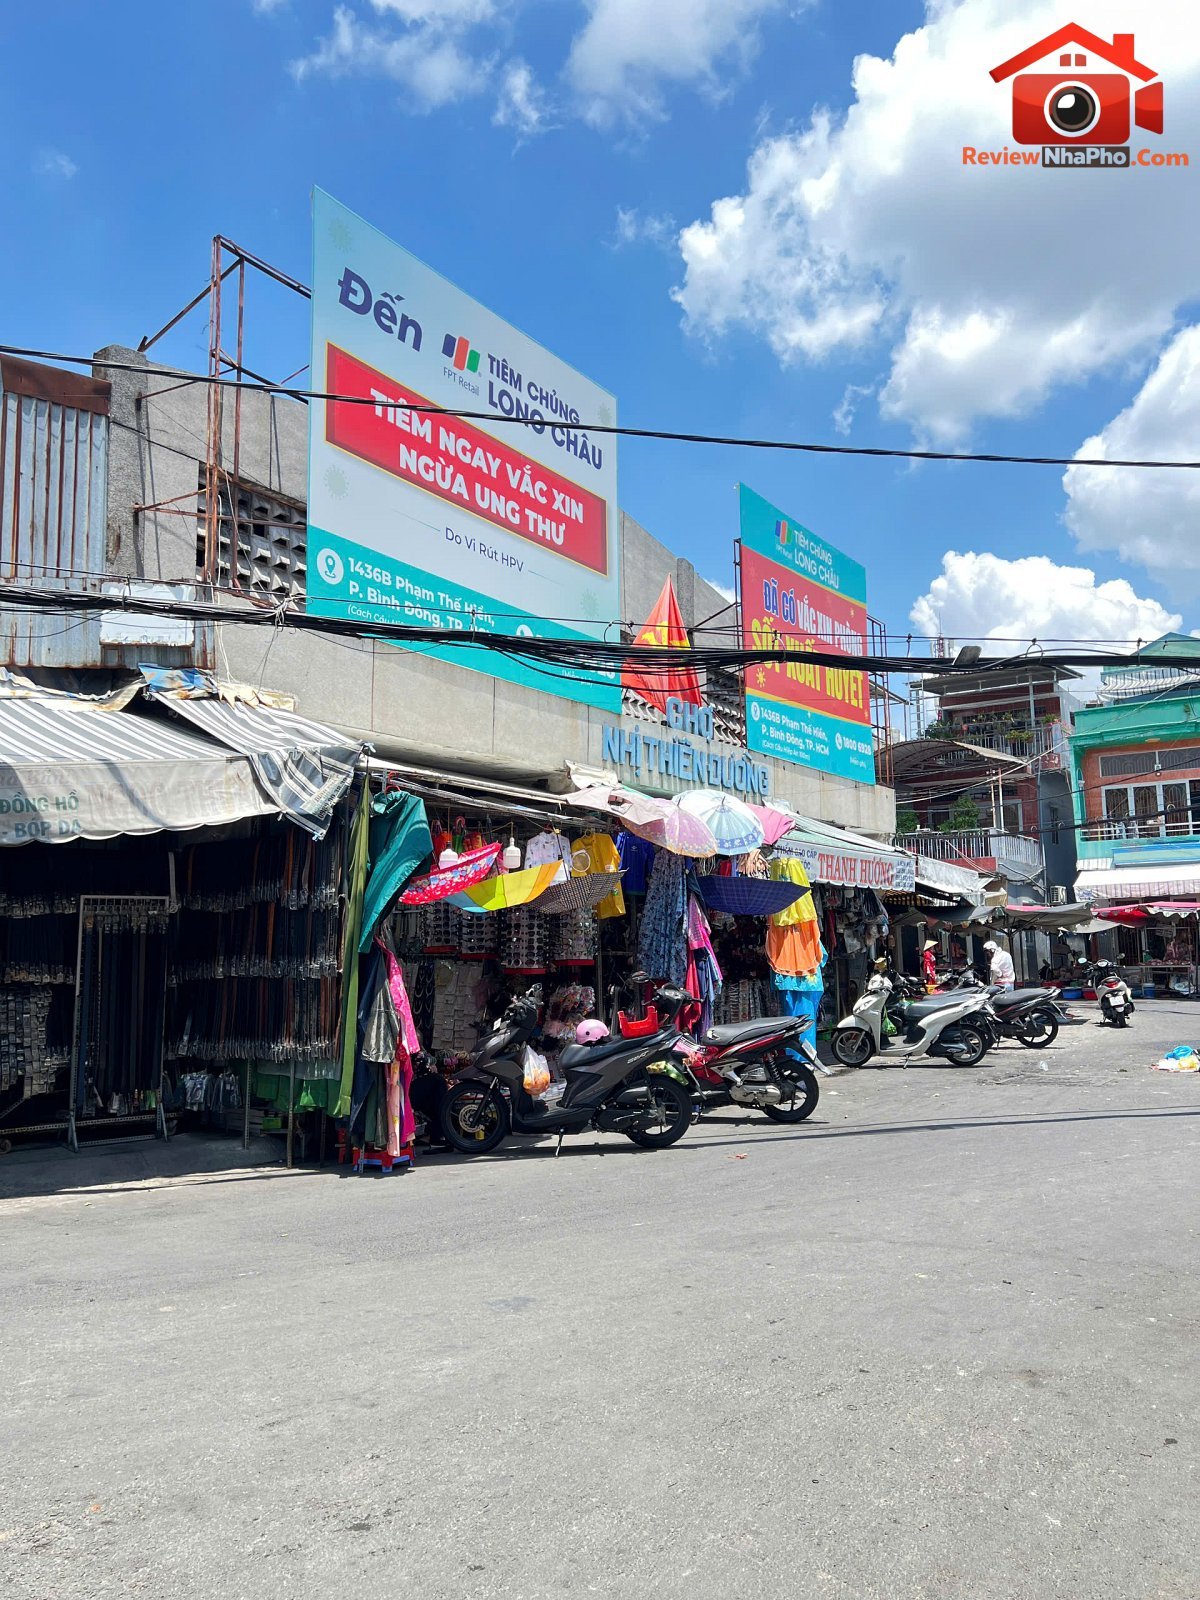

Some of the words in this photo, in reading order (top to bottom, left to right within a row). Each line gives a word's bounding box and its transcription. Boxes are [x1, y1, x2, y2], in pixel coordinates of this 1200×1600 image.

[337, 266, 423, 352] Đến
[443, 367, 457, 384] FPT
[458, 372, 480, 396] Retail
[487, 353, 522, 392] TIÊM
[527, 378, 580, 425] CHỦNG
[487, 381, 545, 435] LONG
[551, 423, 603, 470] CHÂU
[370, 388, 432, 444] TIÊM
[439, 427, 501, 479] NGAY
[506, 463, 547, 504] VẮC
[552, 488, 584, 523] XIN
[400, 444, 469, 501] NGỪA
[475, 483, 520, 524] UNG
[525, 508, 566, 546] THƯ
[445, 527, 462, 545] Do
[465, 538, 476, 553] Vi
[480, 543, 498, 563] Rút
[501, 555, 524, 572] HPV
[794, 530, 809, 550] TIÊM
[348, 557, 392, 586] 1436B
[395, 575, 434, 602] Phạm
[437, 591, 462, 612] Thế
[795, 548, 817, 575] LONG
[818, 565, 839, 589] CHÂU
[347, 604, 372, 620] (Cách
[349, 580, 363, 599] P.
[367, 586, 400, 610] Bình
[404, 600, 444, 628] Đông,
[763, 577, 779, 617] ĐÃ
[781, 588, 796, 625] CÓ
[797, 594, 817, 634] VẮC
[817, 611, 833, 645] XIN
[834, 620, 863, 656] PHÒNG
[666, 697, 714, 743] CHỢ
[760, 707, 781, 723] 1436B
[781, 714, 800, 731] Phạm
[761, 724, 769, 736] P.
[805, 739, 815, 751] TP.
[816, 742, 830, 756] HCM
[602, 724, 641, 777] NHỊ
[643, 735, 705, 785] THIÊN
[0, 791, 49, 814] ĐỒNG
[55, 789, 79, 811] HỒ
[15, 817, 52, 838] BÓP
[59, 819, 81, 835] DA
[806, 848, 817, 859] CẤP
[818, 853, 857, 882] THANH
